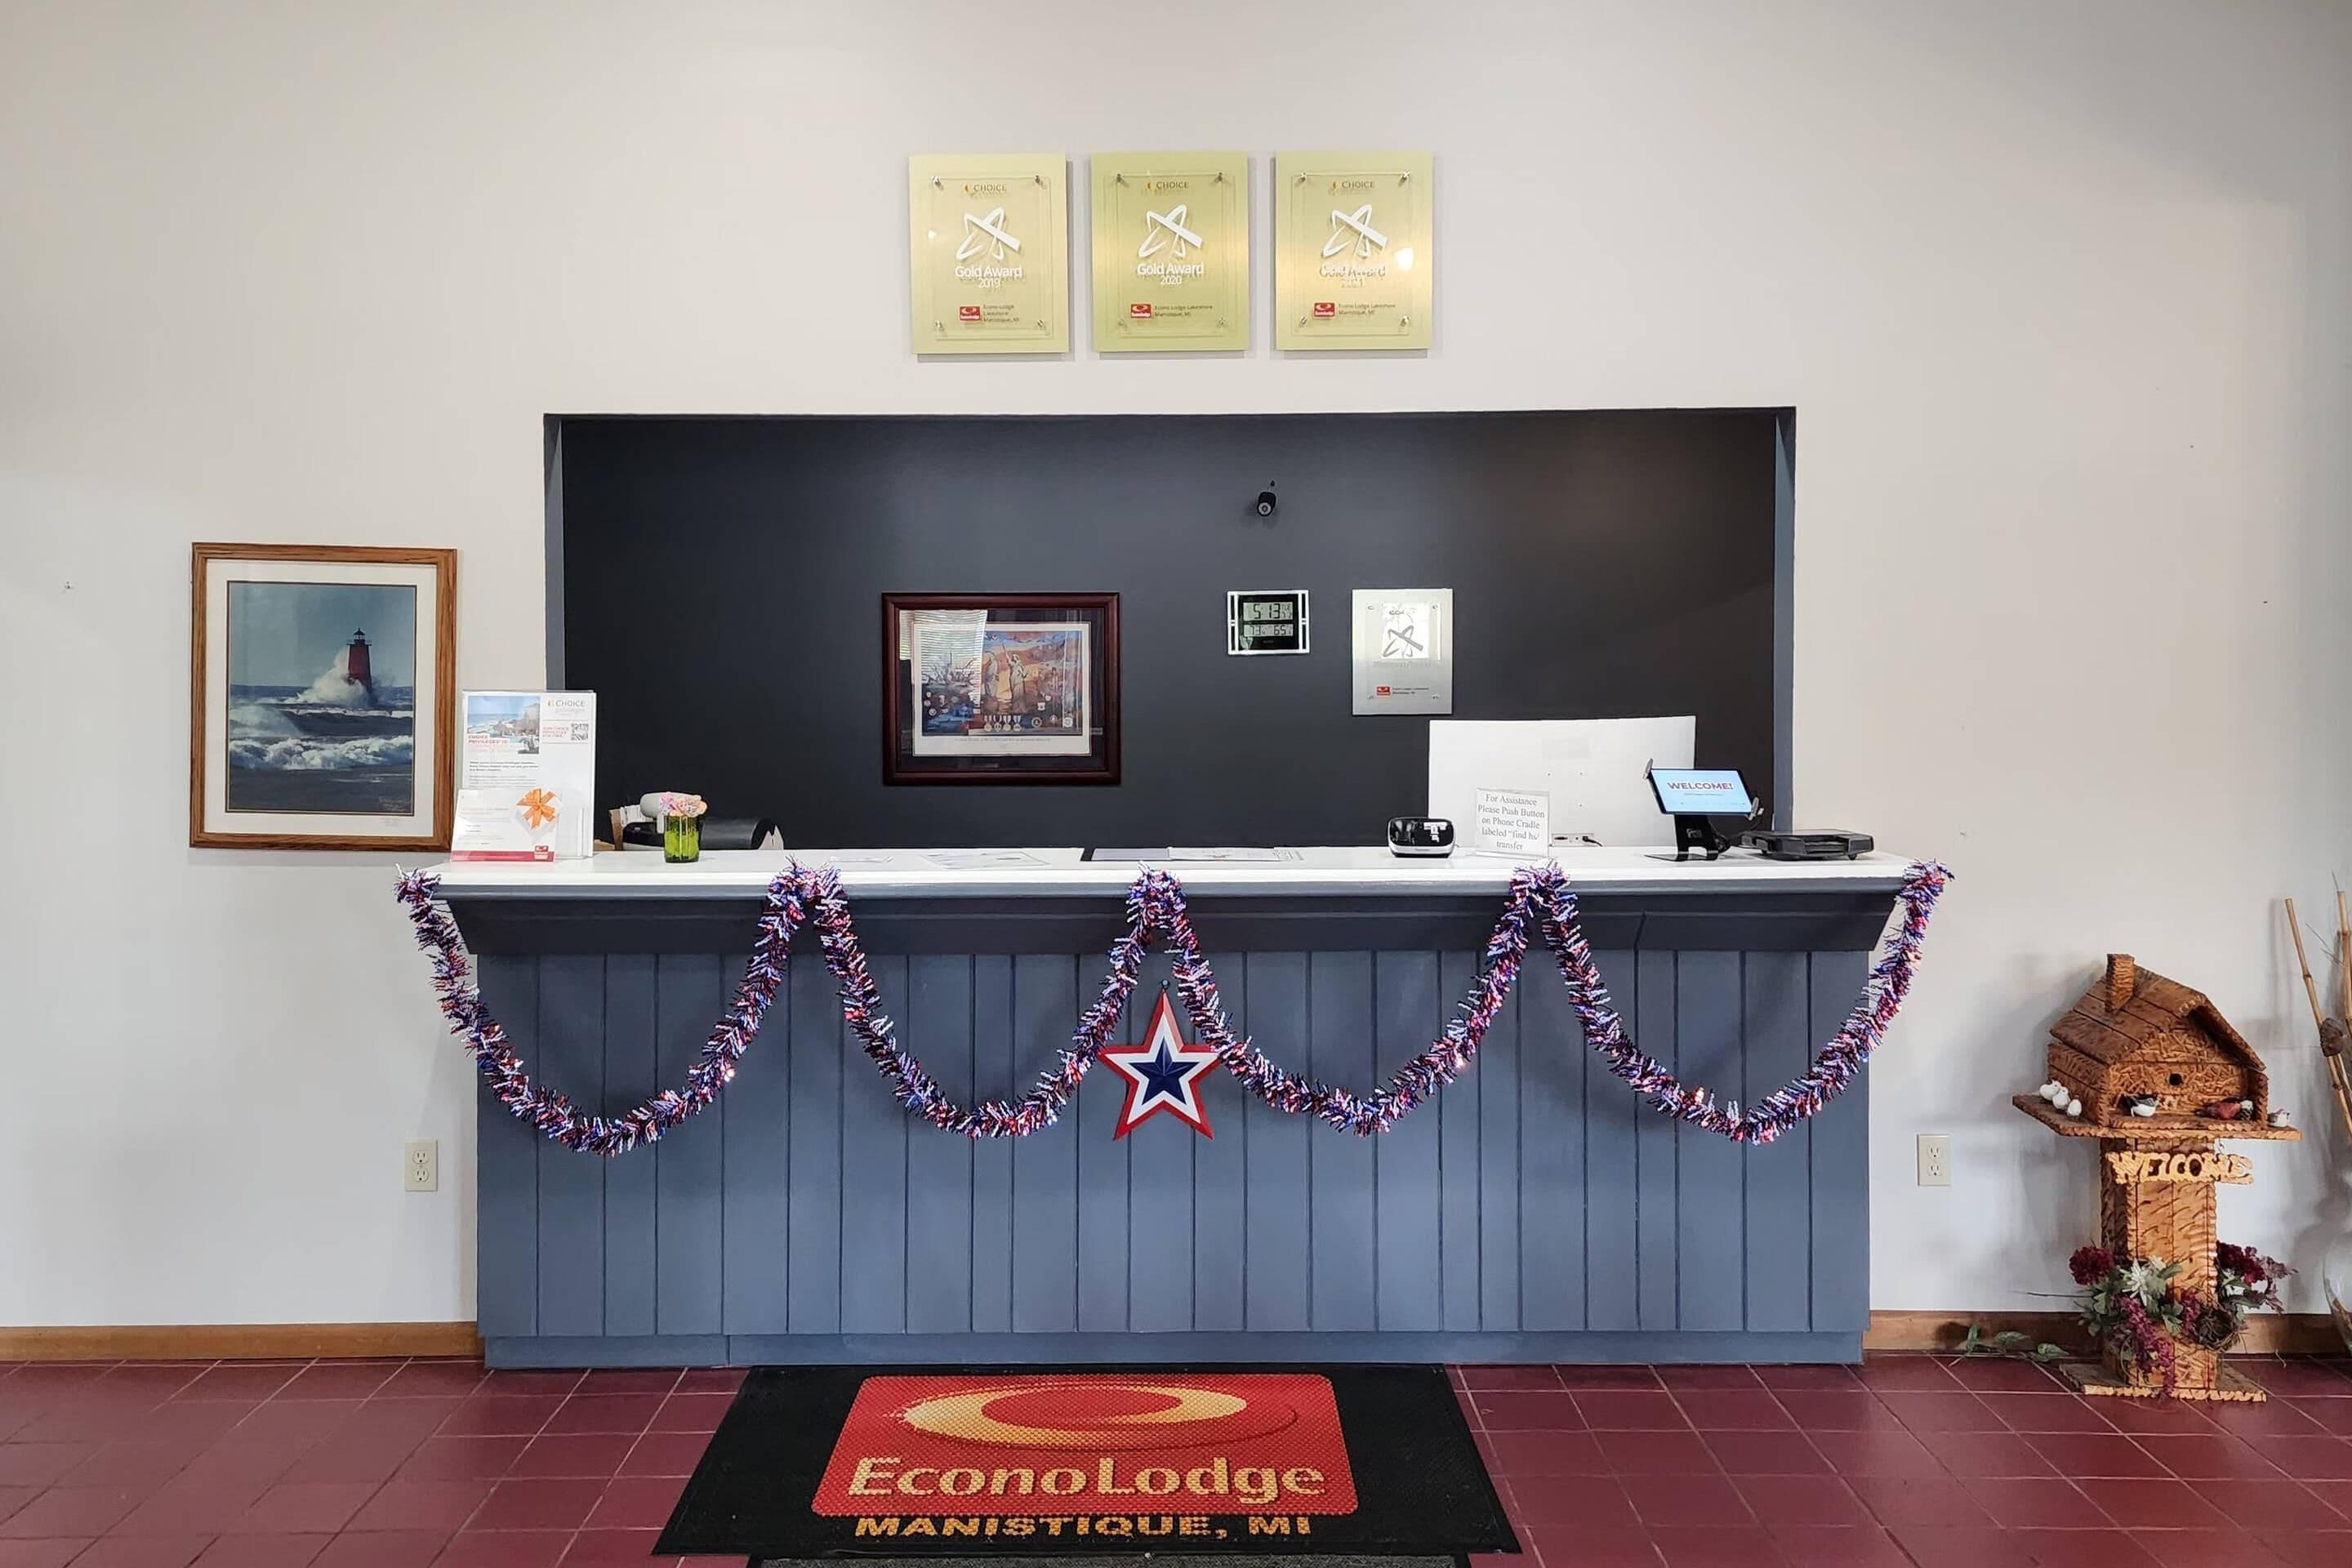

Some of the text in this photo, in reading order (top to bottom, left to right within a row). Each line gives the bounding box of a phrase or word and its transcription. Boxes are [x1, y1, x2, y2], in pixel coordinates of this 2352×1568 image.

[973, 184, 1006, 192] CHOICE
[1156, 181, 1189, 189] CHOICE
[1342, 181, 1375, 189] CHOICE
[955, 264, 1022, 278] Gold Award
[1137, 261, 1205, 275] Gold Award
[978, 278, 1001, 288] 2019
[1160, 274, 1183, 286] 2020
[555, 699, 586, 707] CHOICE
[1667, 782, 1734, 791] WELCOME!
[1486, 793, 1538, 806] For Assistance
[1477, 804, 1545, 818] Please Push Button
[1492, 816, 1515, 826] Phone
[1516, 819, 1540, 830] Cradle
[1481, 826, 1507, 837] labeled
[1495, 840, 1524, 850] transfer
[2105, 1150, 2255, 1185] WELCOME
[847, 1456, 1326, 1504] EconoLodge
[854, 1517, 1312, 1539] MANISTIQUE, MI
